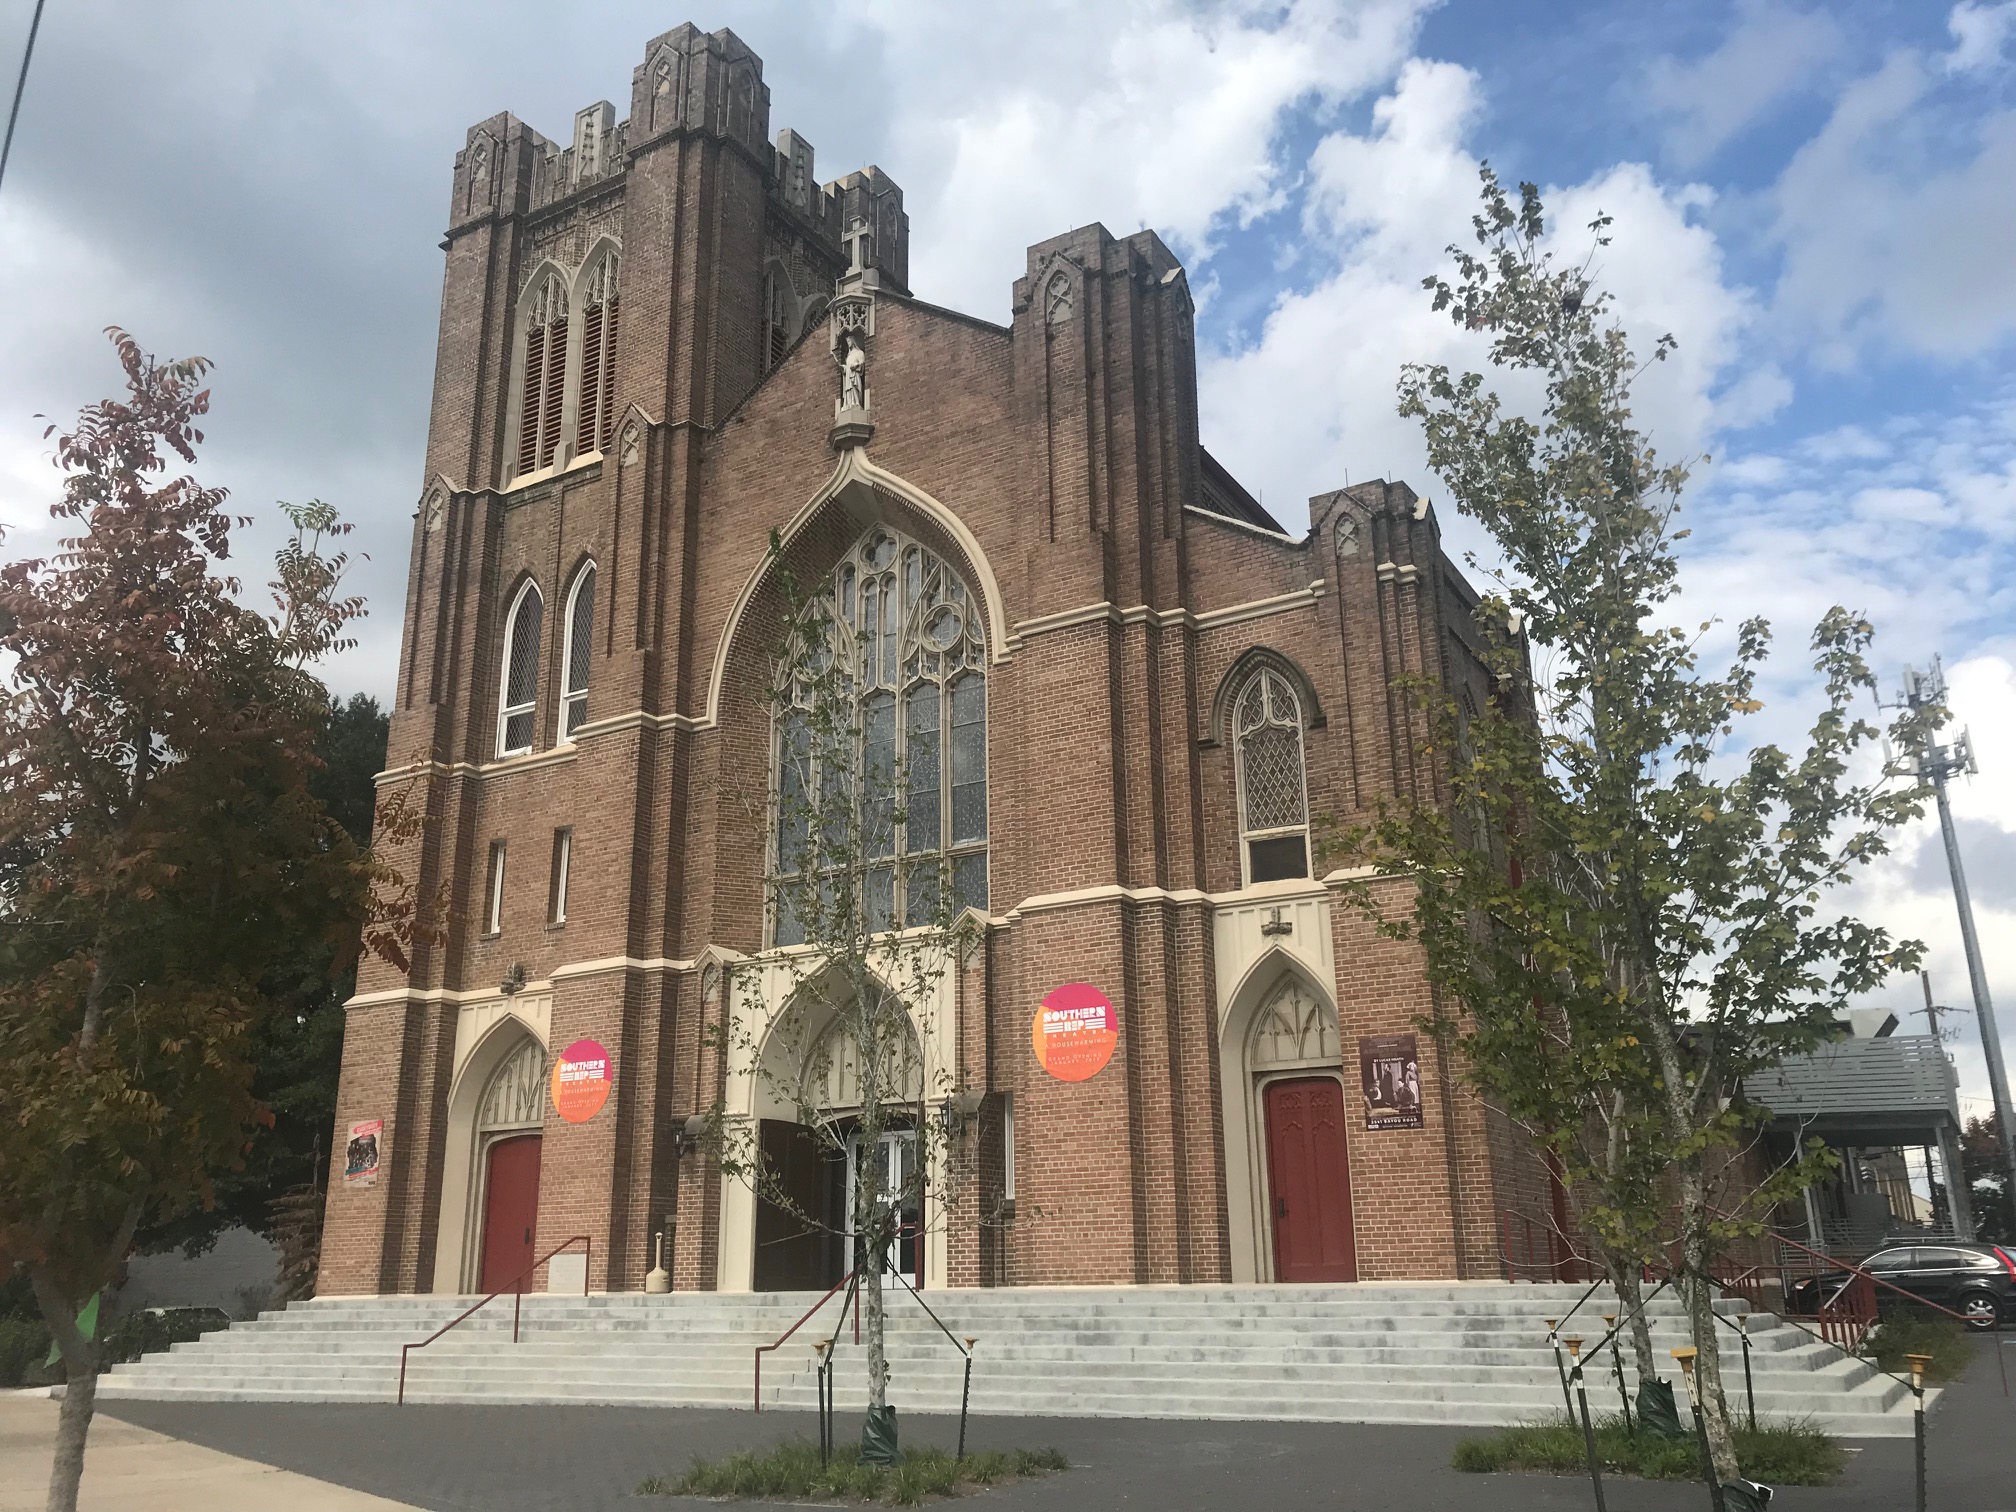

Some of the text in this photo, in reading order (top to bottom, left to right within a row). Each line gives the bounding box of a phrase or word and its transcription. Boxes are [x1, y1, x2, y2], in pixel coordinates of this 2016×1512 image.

[1043, 1006, 1106, 1022] SOUTHERN
[1064, 1020, 1085, 1032] REP
[1043, 1029, 1106, 1039] THEATRE
[1052, 1037, 1107, 1048] HOUSEWARMING
[560, 1059, 605, 1073] SOUTHERN
[574, 1070, 589, 1081] REP
